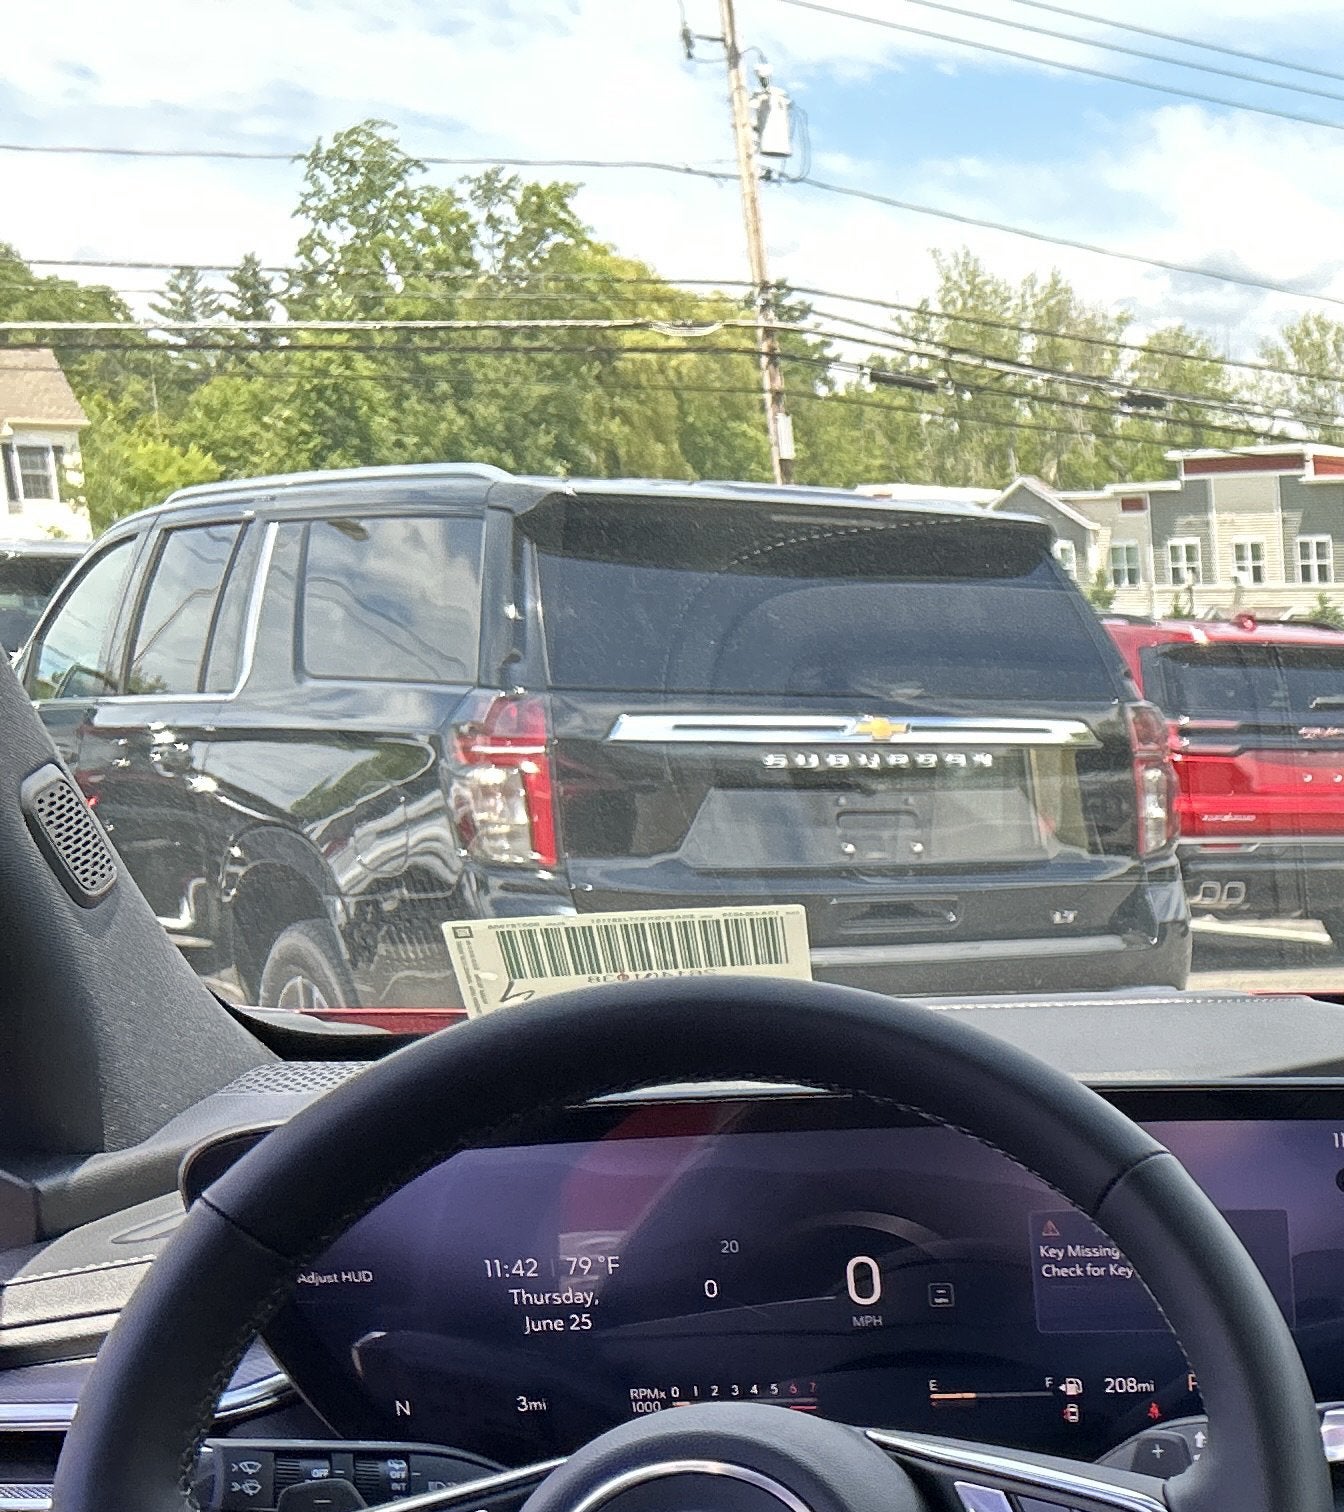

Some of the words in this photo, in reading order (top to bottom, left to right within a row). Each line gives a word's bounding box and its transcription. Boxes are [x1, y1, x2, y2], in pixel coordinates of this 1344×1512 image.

[720, 1240, 740, 1254] 20
[1040, 1245, 1065, 1261] Key
[1067, 1245, 1120, 1260] Missing
[484, 1258, 539, 1278] 11:42
[1041, 1263, 1084, 1278] Check
[1086, 1262, 1106, 1277] for
[1109, 1264, 1134, 1279] Key
[342, 1270, 373, 1283] HUD
[846, 1255, 882, 1306] 0
[704, 1279, 718, 1298] 0
[508, 1289, 600, 1307] Thursday,
[524, 1316, 565, 1334] June
[569, 1314, 592, 1330] 25
[852, 1315, 883, 1327] MPH
[929, 1379, 938, 1391] E
[1045, 1376, 1053, 1388] F
[1104, 1377, 1155, 1394] 208mi
[630, 1388, 667, 1400] RPMx
[671, 1386, 680, 1398] 0
[710, 1385, 720, 1397] 2
[731, 1384, 739, 1396] 3
[750, 1384, 758, 1395] 4
[770, 1383, 779, 1394] 5
[395, 1400, 411, 1416] N
[516, 1395, 547, 1412] 3mi
[632, 1401, 662, 1413] 1000
[389, 1471, 407, 1479] OFF
